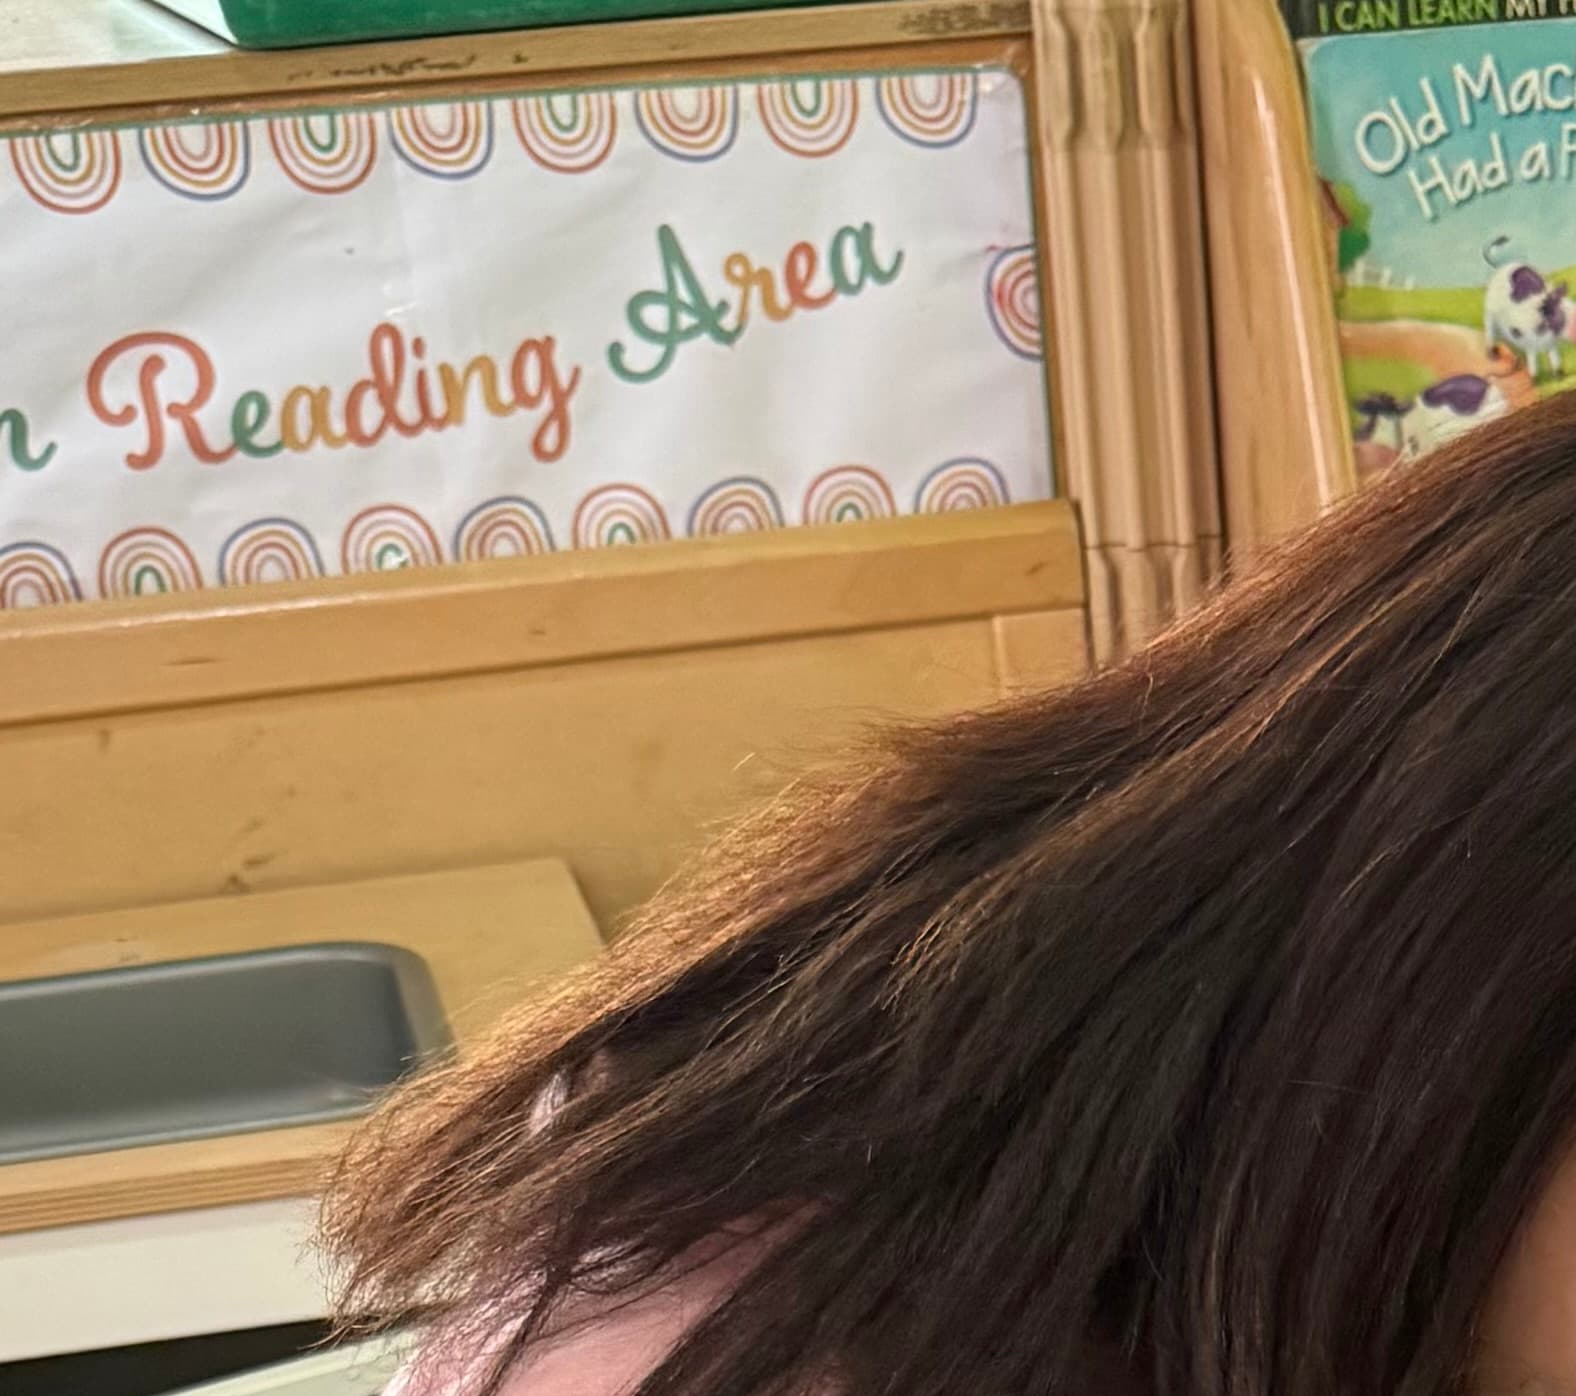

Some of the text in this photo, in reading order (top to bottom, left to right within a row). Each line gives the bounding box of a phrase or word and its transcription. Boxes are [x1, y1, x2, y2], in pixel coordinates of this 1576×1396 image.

[1319, 9, 1328, 33] I
[1335, 4, 1399, 32] CAN
[1407, 0, 1497, 30] LEARN
[1355, 78, 1450, 175] Old
[1408, 133, 1508, 221] Had
[1519, 142, 1551, 180] a
[86, 322, 583, 471] Reading
[606, 221, 904, 383] Area
